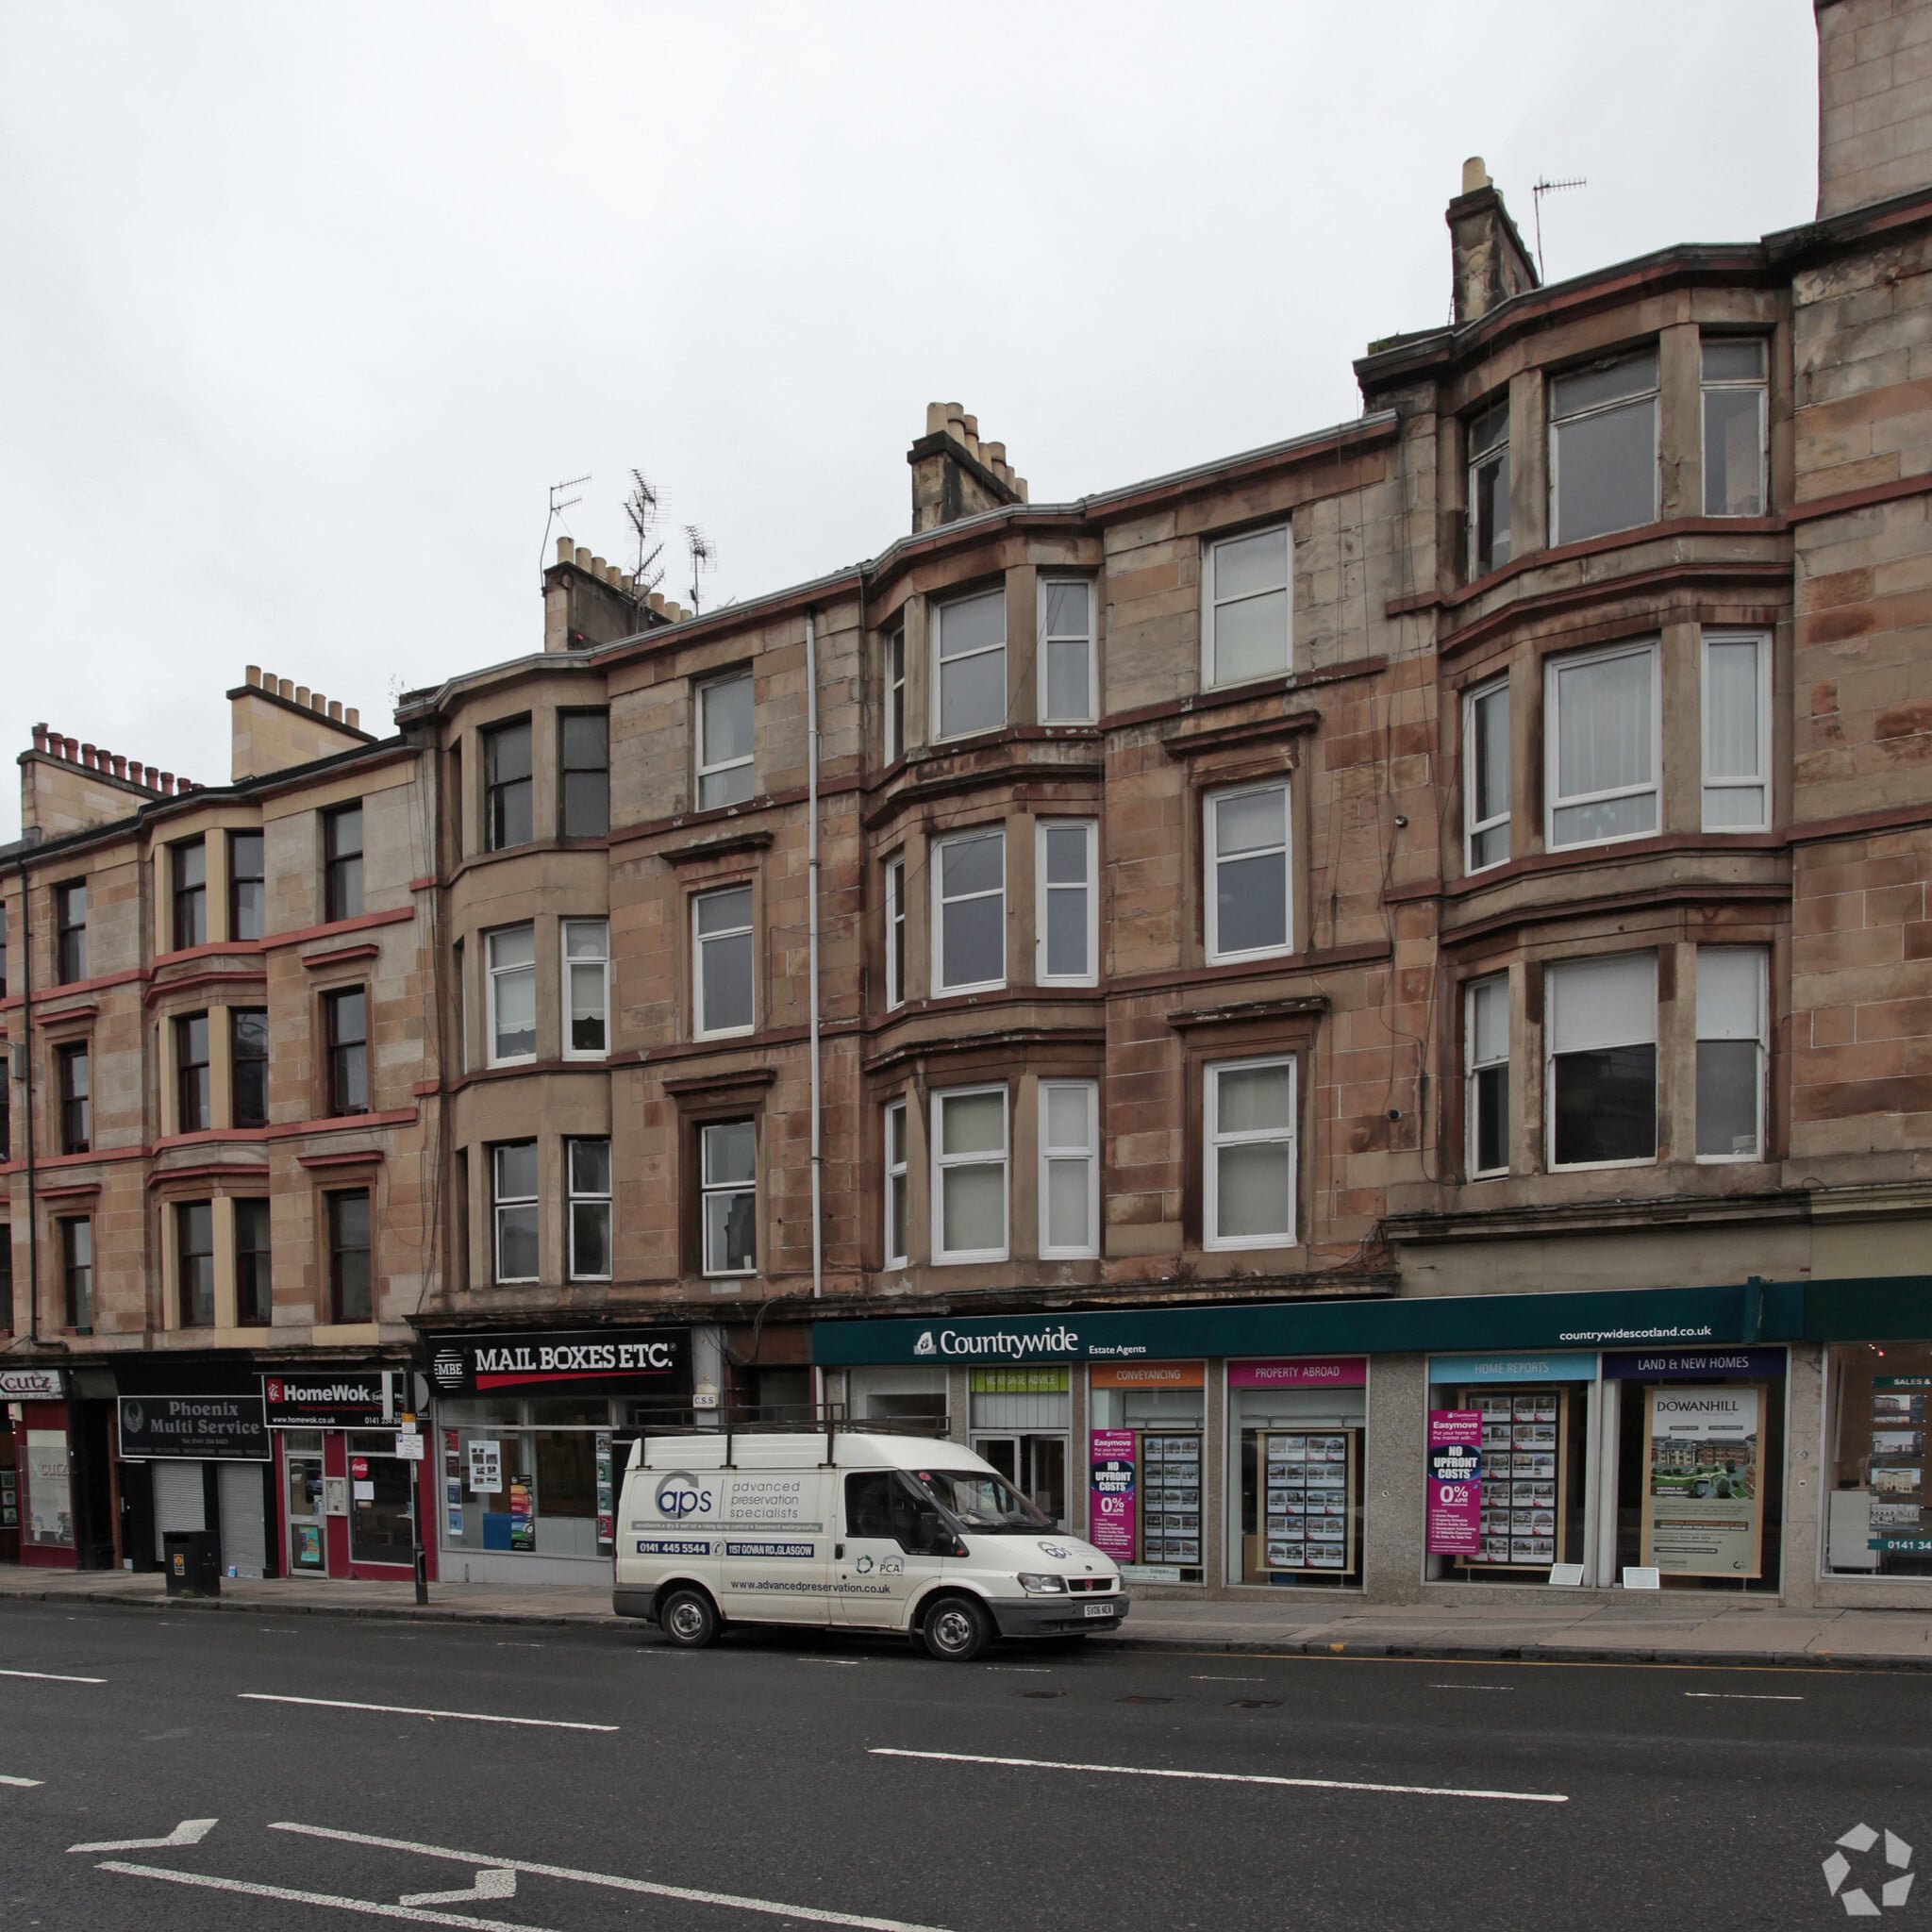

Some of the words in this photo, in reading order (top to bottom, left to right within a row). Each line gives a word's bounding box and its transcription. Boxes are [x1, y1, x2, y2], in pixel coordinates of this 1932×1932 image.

[1559, 1325, 1711, 1341] countrywidescotland.co.uk
[940, 1326, 1079, 1358] Countrywide
[1089, 1345, 1115, 1354] Estate
[1116, 1345, 1147, 1356] Agents
[475, 1347, 537, 1372] MAIL
[540, 1344, 616, 1370] BOXES
[619, 1342, 673, 1368] ETC.
[438, 1363, 462, 1375] MBE
[1474, 1362, 1504, 1374] HOME
[1507, 1361, 1549, 1374] REPORTS
[1638, 1358, 1665, 1370] LAND
[1669, 1358, 1677, 1370] &
[1681, 1357, 1706, 1369] NEW
[1709, 1357, 1749, 1369] HOMES
[1116, 1370, 1181, 1381] CONVEYANCING
[1256, 1367, 1298, 1378] PROPERTY
[1303, 1366, 1340, 1377] ABROAD
[284, 1385, 371, 1402] HomeWok
[169, 1401, 239, 1416] Phoenix
[1657, 1400, 1739, 1412] DOWANHILL
[272, 1416, 336, 1424] www.homewok.co.uk
[1433, 1421, 1477, 1430] Easymove
[150, 1419, 192, 1433] Multi
[197, 1419, 260, 1434] Service
[1094, 1439, 1131, 1447] Easymove
[1448, 1445, 1462, 1457] NO
[1107, 1461, 1119, 1471] NO
[1434, 1457, 1477, 1468] UPFRONT
[1095, 1472, 1131, 1481] UPFRONT
[732, 1481, 800, 1492] advanced
[658, 1491, 712, 1519] aps
[731, 1494, 799, 1507] preservation
[729, 1507, 798, 1519] specialists
[640, 1543, 658, 1553] 0141
[662, 1543, 680, 1553] 445
[682, 1543, 706, 1554] 5544
[741, 1544, 764, 1555] GOVAN
[1888, 1541, 1914, 1549] 0141
[879, 1564, 900, 1573] PCA
[730, 1580, 891, 1593] www.advancedpreservation.co.uk
